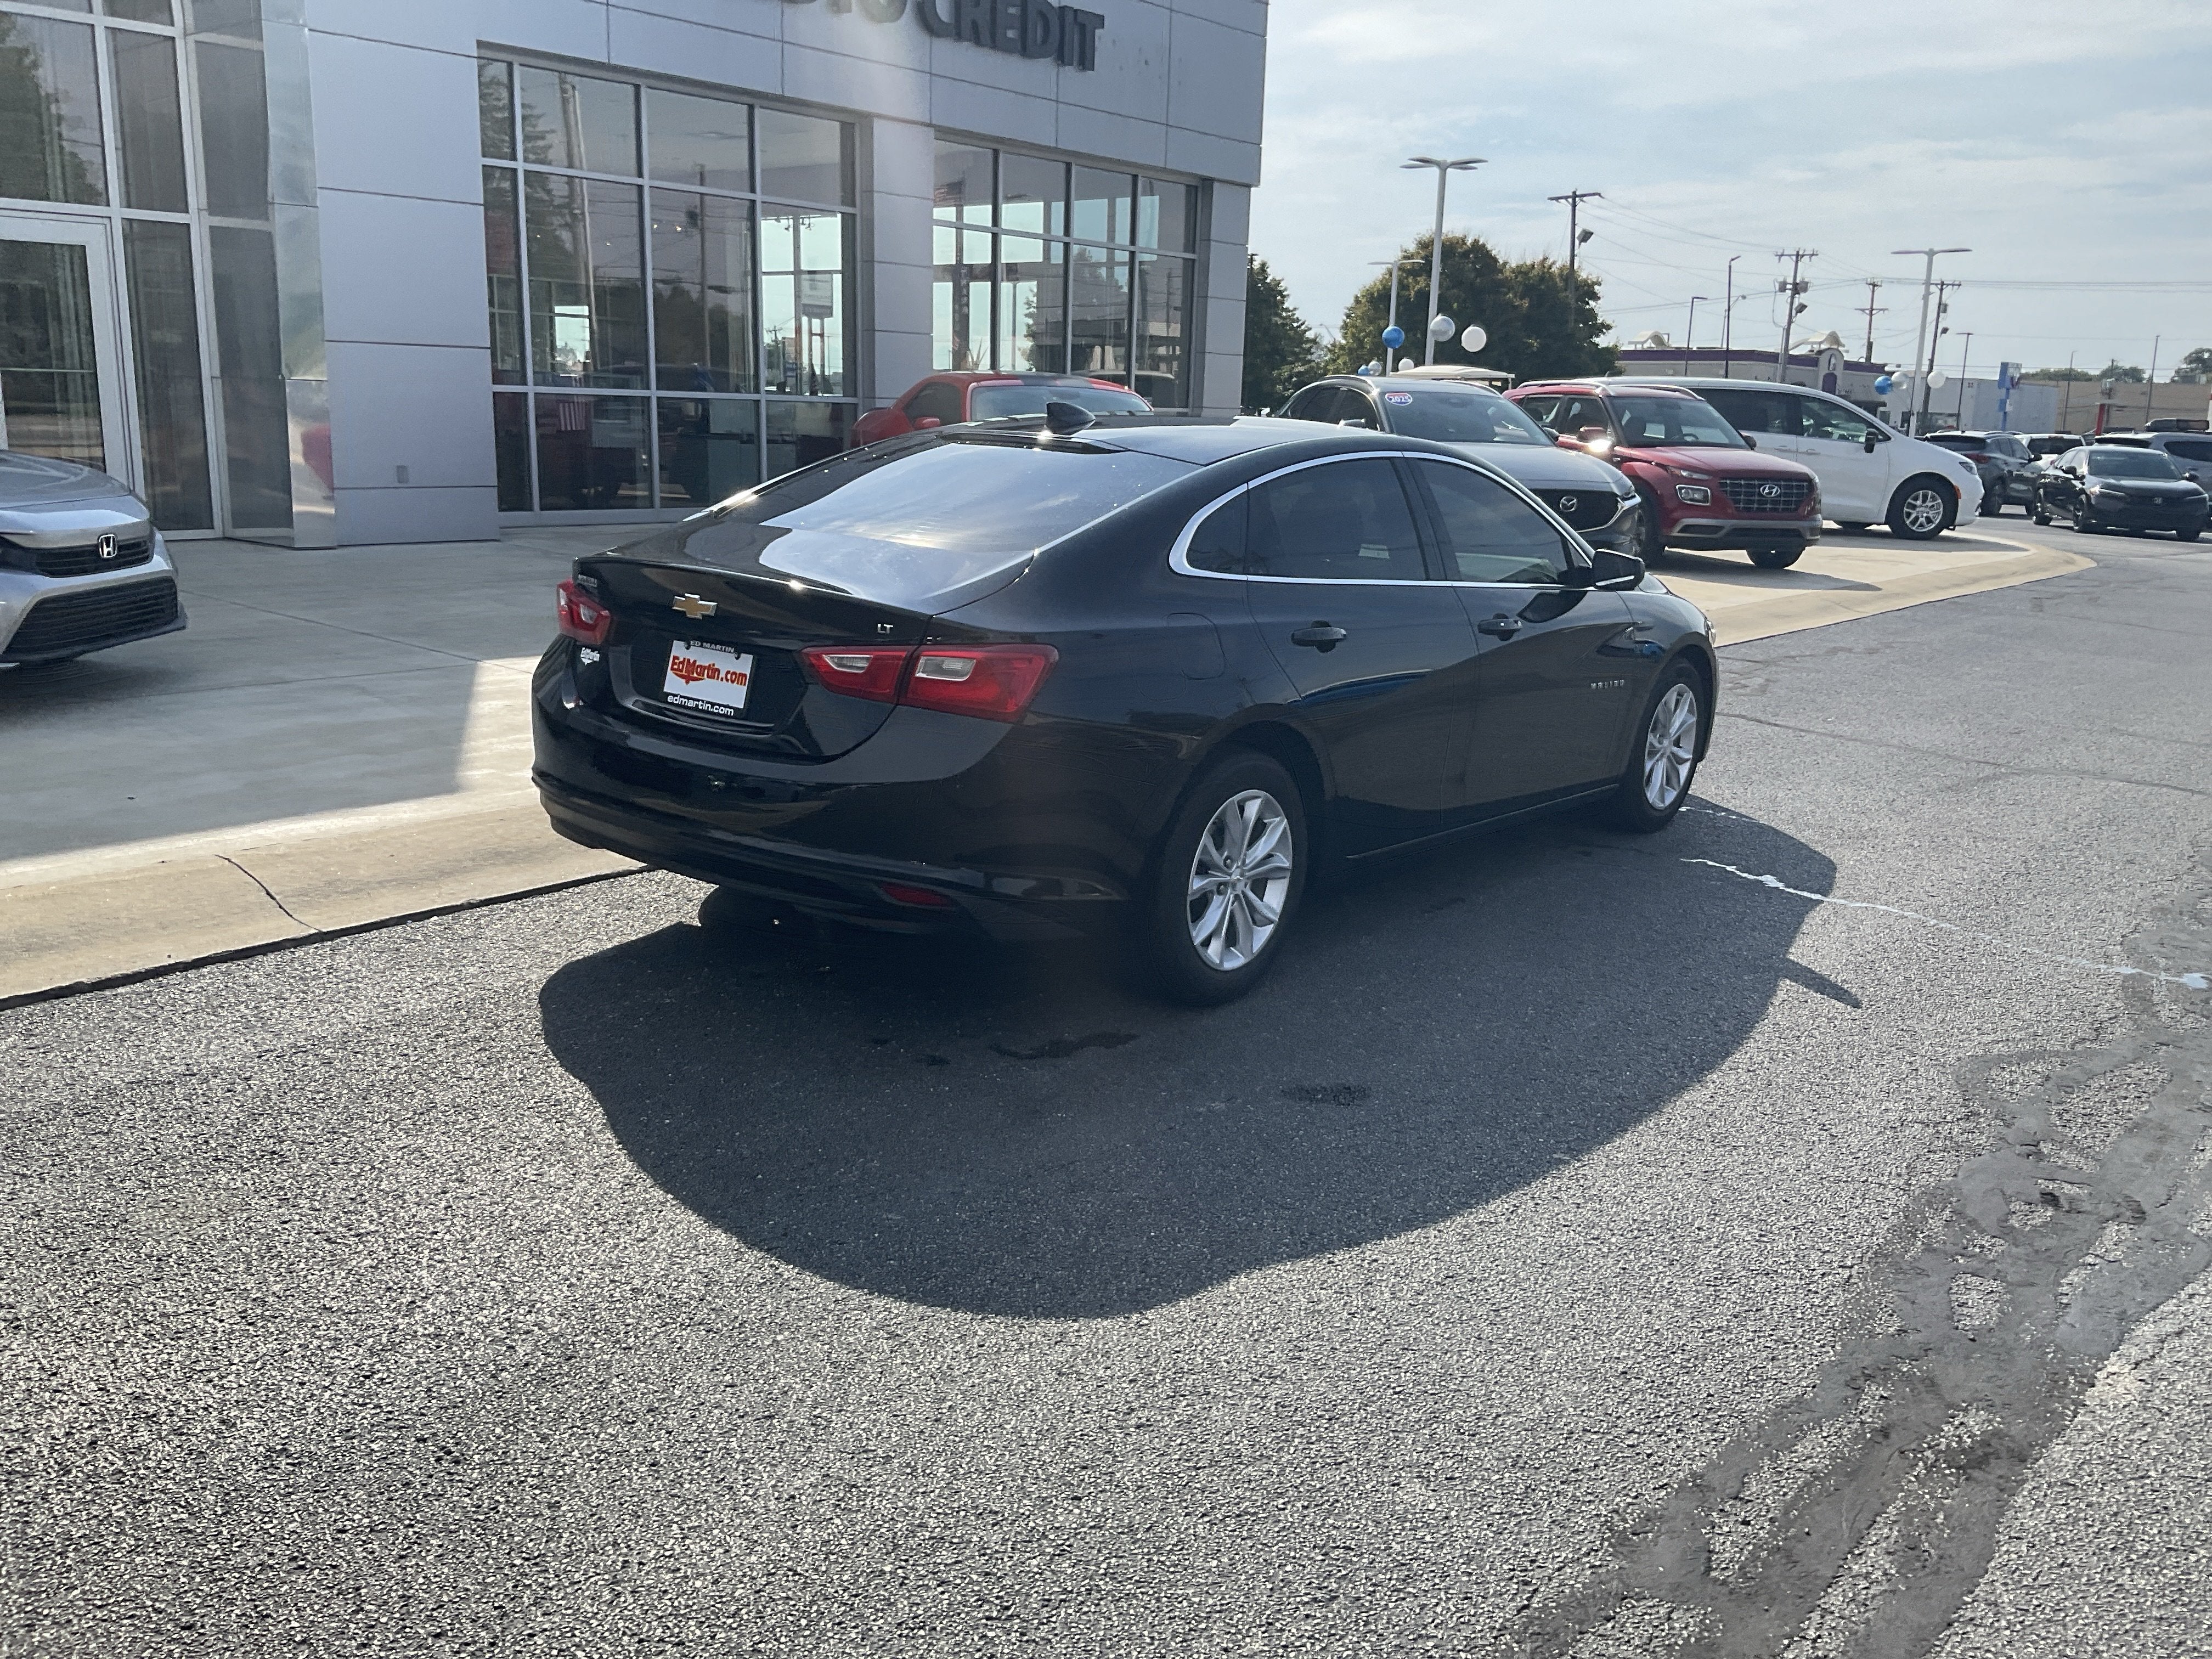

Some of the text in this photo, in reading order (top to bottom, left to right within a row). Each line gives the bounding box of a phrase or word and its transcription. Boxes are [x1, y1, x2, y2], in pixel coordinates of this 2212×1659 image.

[878, 623, 893, 634] LT
[703, 642, 735, 653] MARTIN
[667, 695, 734, 716] edmartin.com
